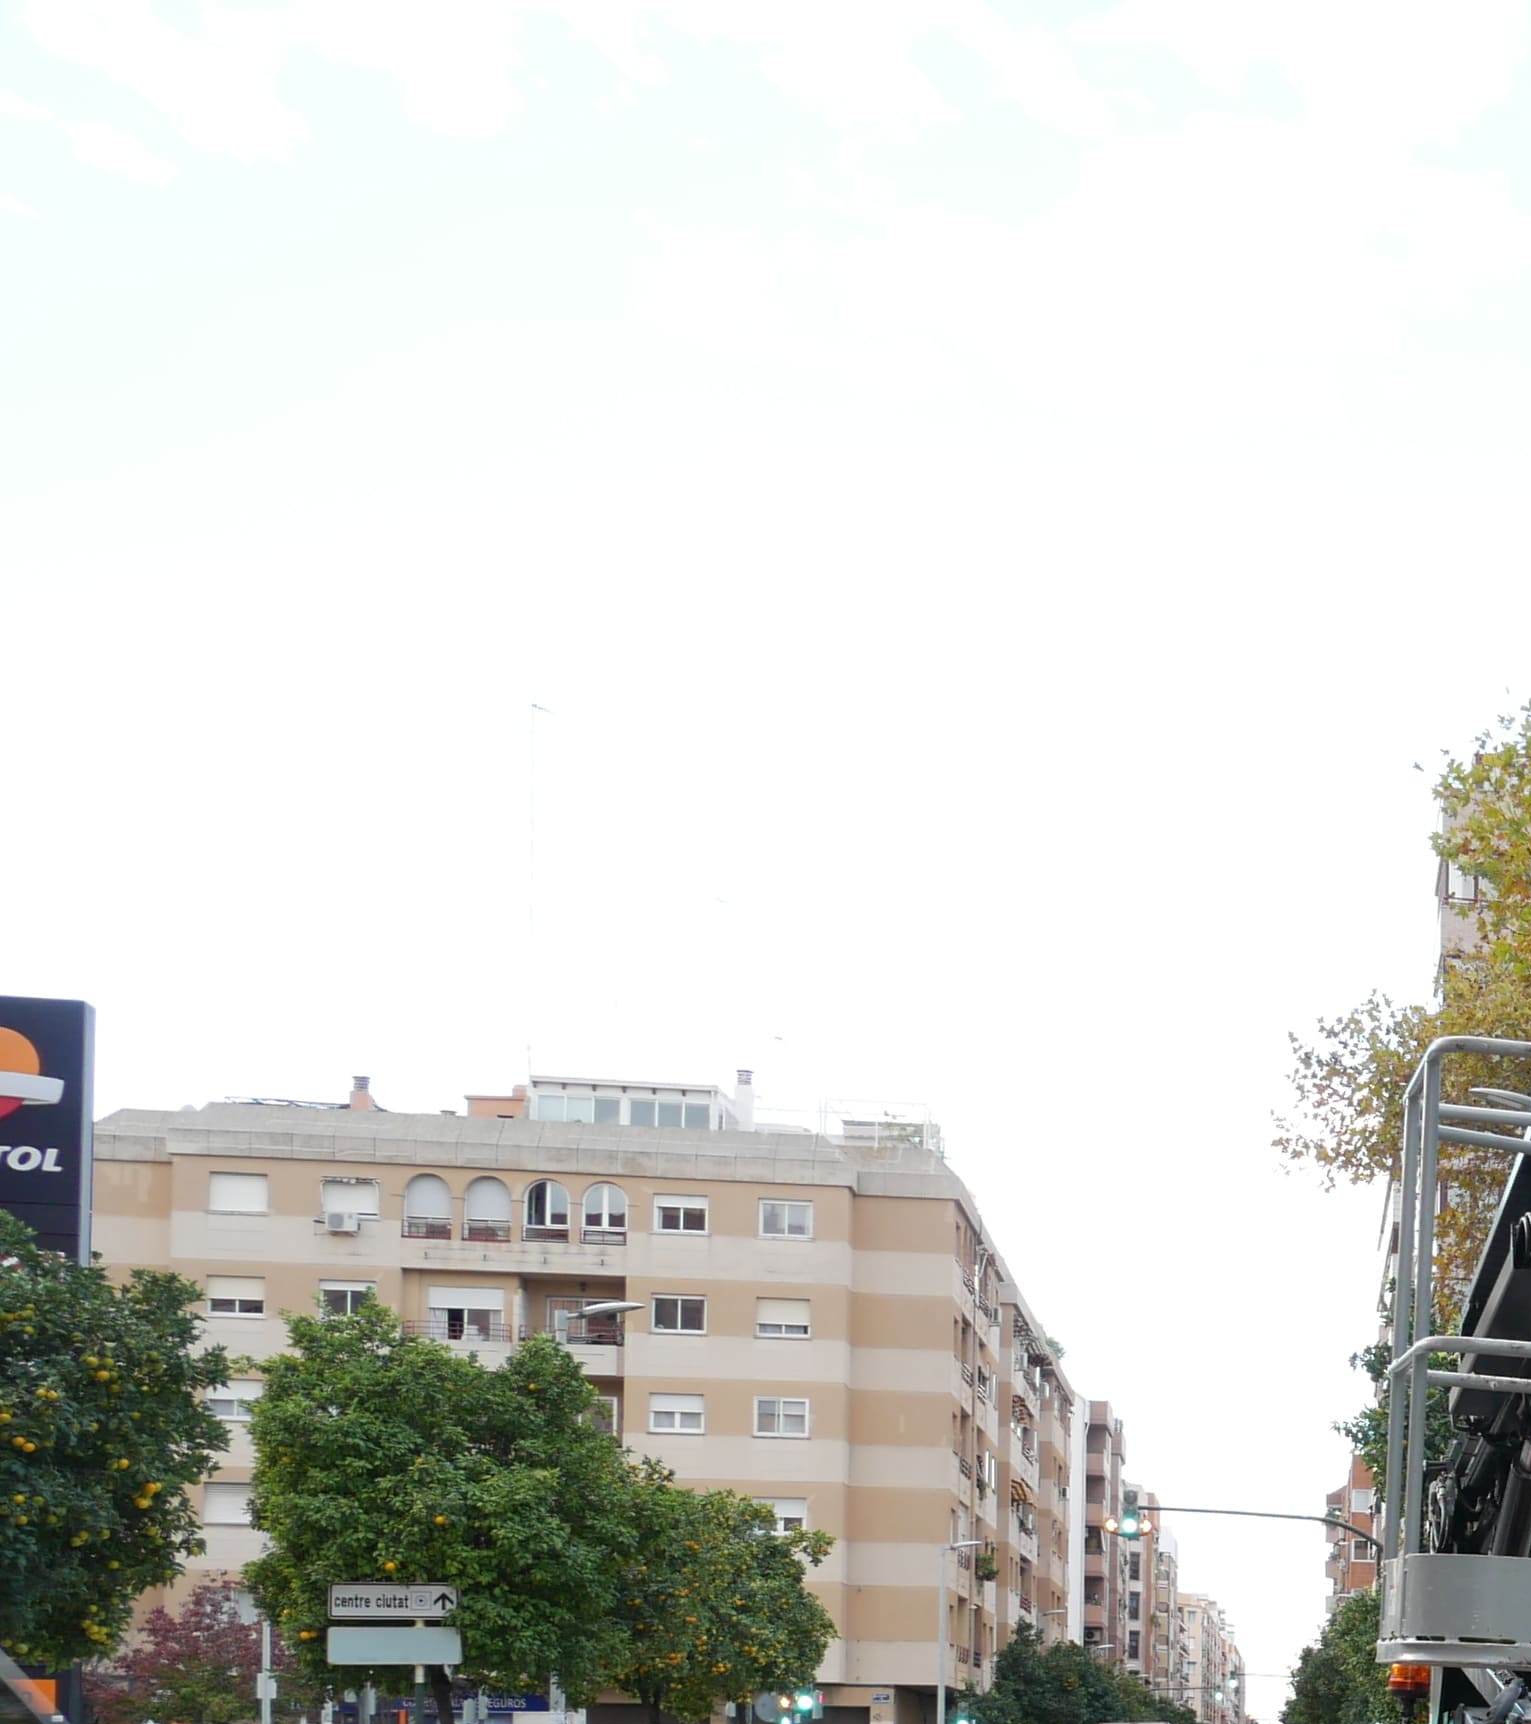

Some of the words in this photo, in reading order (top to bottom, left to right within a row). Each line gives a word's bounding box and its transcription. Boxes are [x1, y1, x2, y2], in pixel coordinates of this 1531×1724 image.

[334, 1595, 371, 1608] centre
[376, 1594, 409, 1608] ciutat
[484, 1697, 527, 1709] EGUROS
